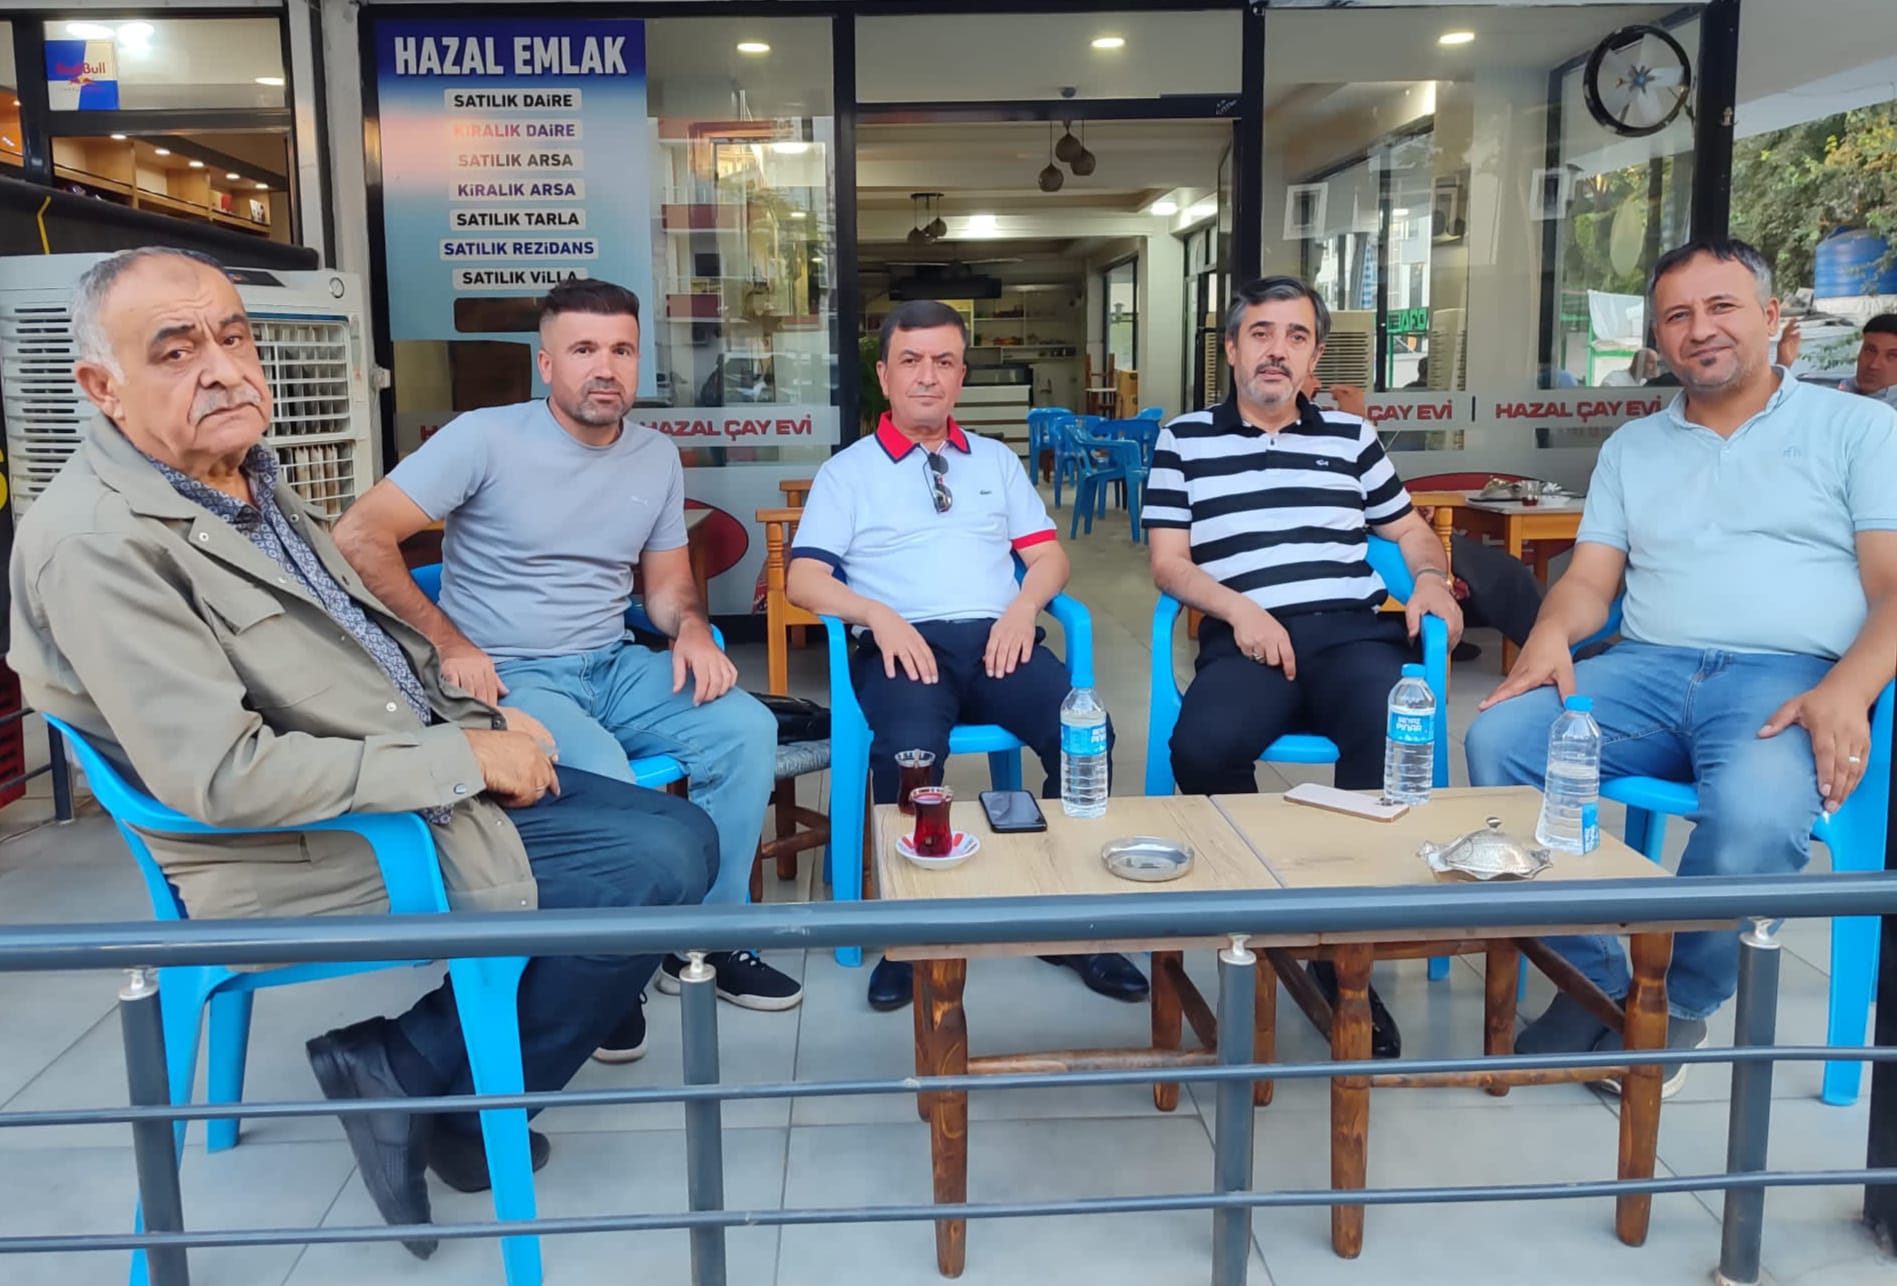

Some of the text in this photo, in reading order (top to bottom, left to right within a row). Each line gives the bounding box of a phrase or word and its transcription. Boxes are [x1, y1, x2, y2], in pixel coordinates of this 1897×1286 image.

[394, 36, 627, 75] HAZAL EMLAK
[83, 62, 105, 74] Bull
[454, 94, 518, 108] SATILIK
[458, 153, 573, 167] SATILIK ARSA
[530, 183, 576, 196] ARSA
[457, 212, 579, 226] SATILIK TARLA
[444, 242, 507, 255] SATILIK
[462, 271, 526, 285] SATILIK
[1367, 398, 1453, 427] ÇAY EVİ
[1495, 402, 1573, 419] HAZAL
[1576, 401, 1623, 423] ÇAY
[724, 419, 772, 441] ÇAY
[775, 414, 812, 435] EVİ
